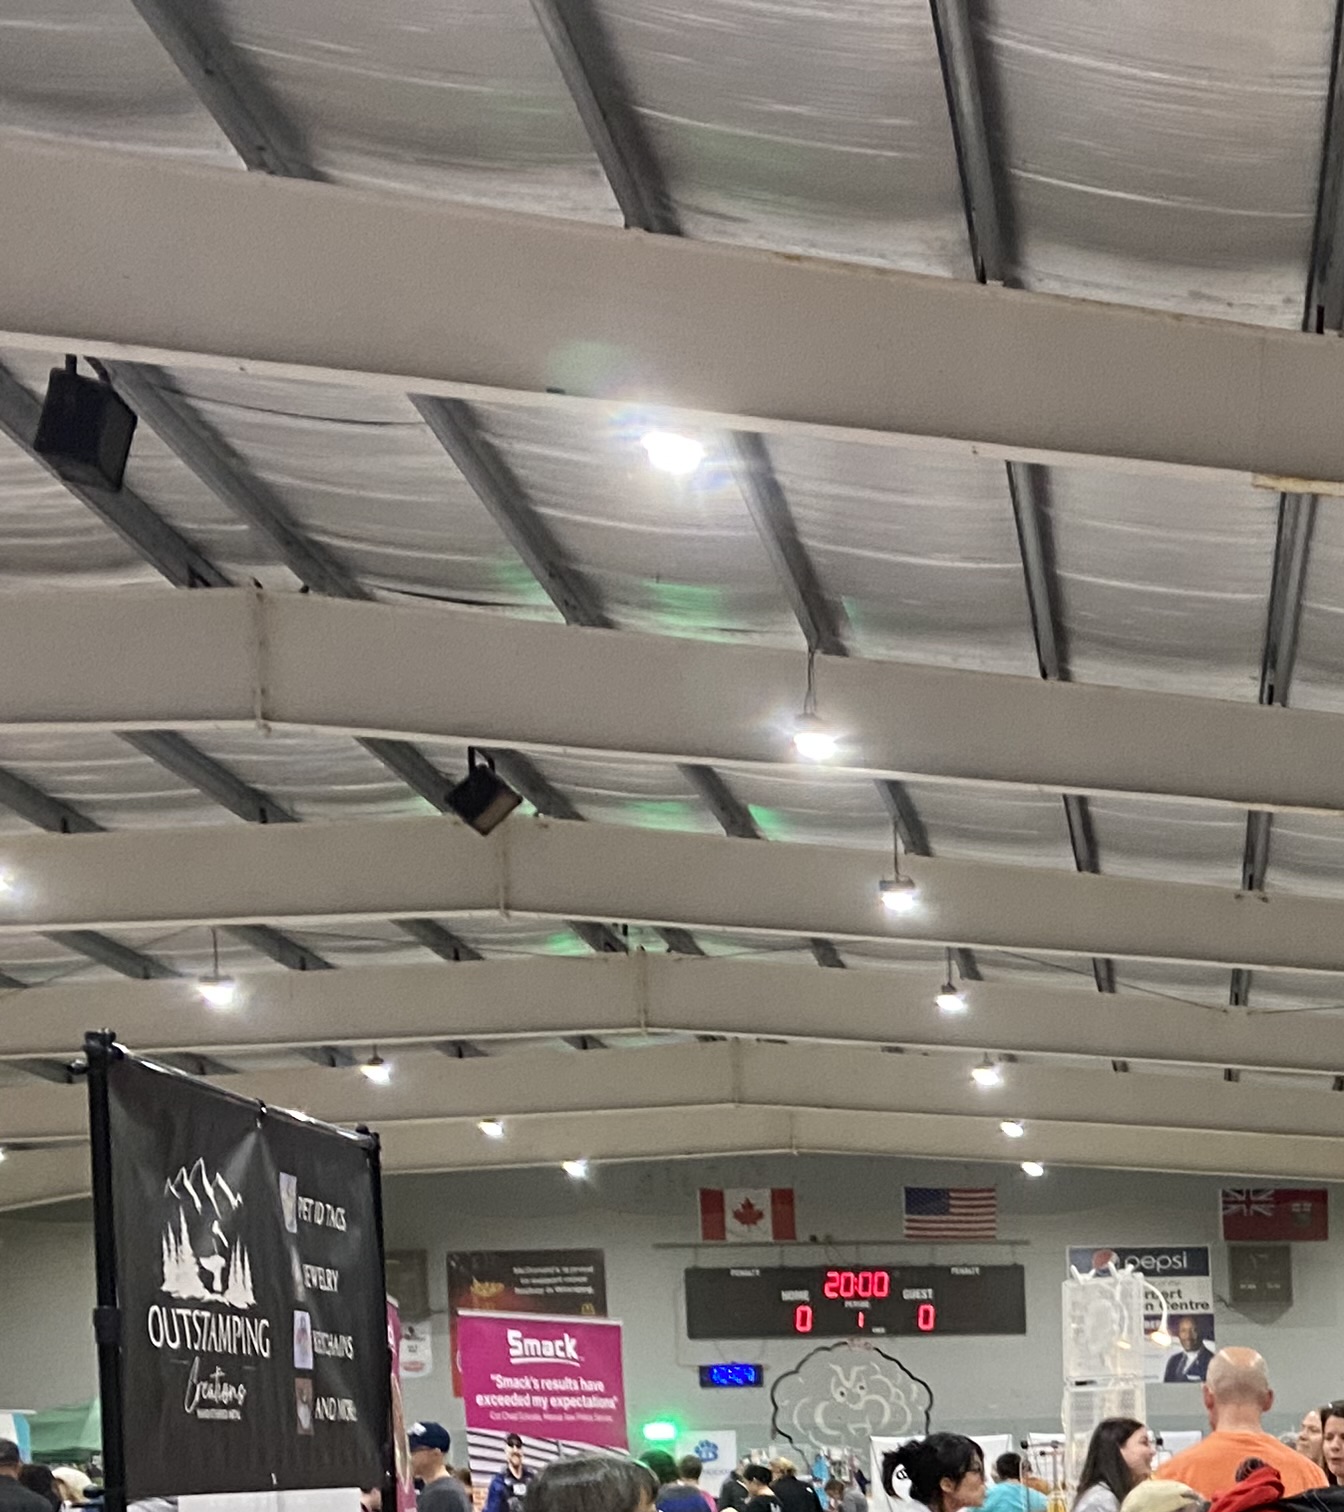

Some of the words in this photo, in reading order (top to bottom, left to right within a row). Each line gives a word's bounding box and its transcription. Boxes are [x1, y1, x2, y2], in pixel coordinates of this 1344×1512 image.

[1124, 1251, 1187, 1272] pepsi
[824, 1270, 890, 1299] 20:00
[902, 1288, 934, 1300] GUEST
[147, 1304, 270, 1359] OUTSTAMPING
[795, 1304, 813, 1333] 0
[857, 1311, 865, 1329] 1
[917, 1303, 936, 1332] 0
[507, 1328, 579, 1360] Smack
[184, 1356, 247, 1413] Creations
[541, 1376, 579, 1391] results
[580, 1376, 605, 1393] have
[475, 1393, 530, 1408] exceeded
[532, 1395, 548, 1411] my
